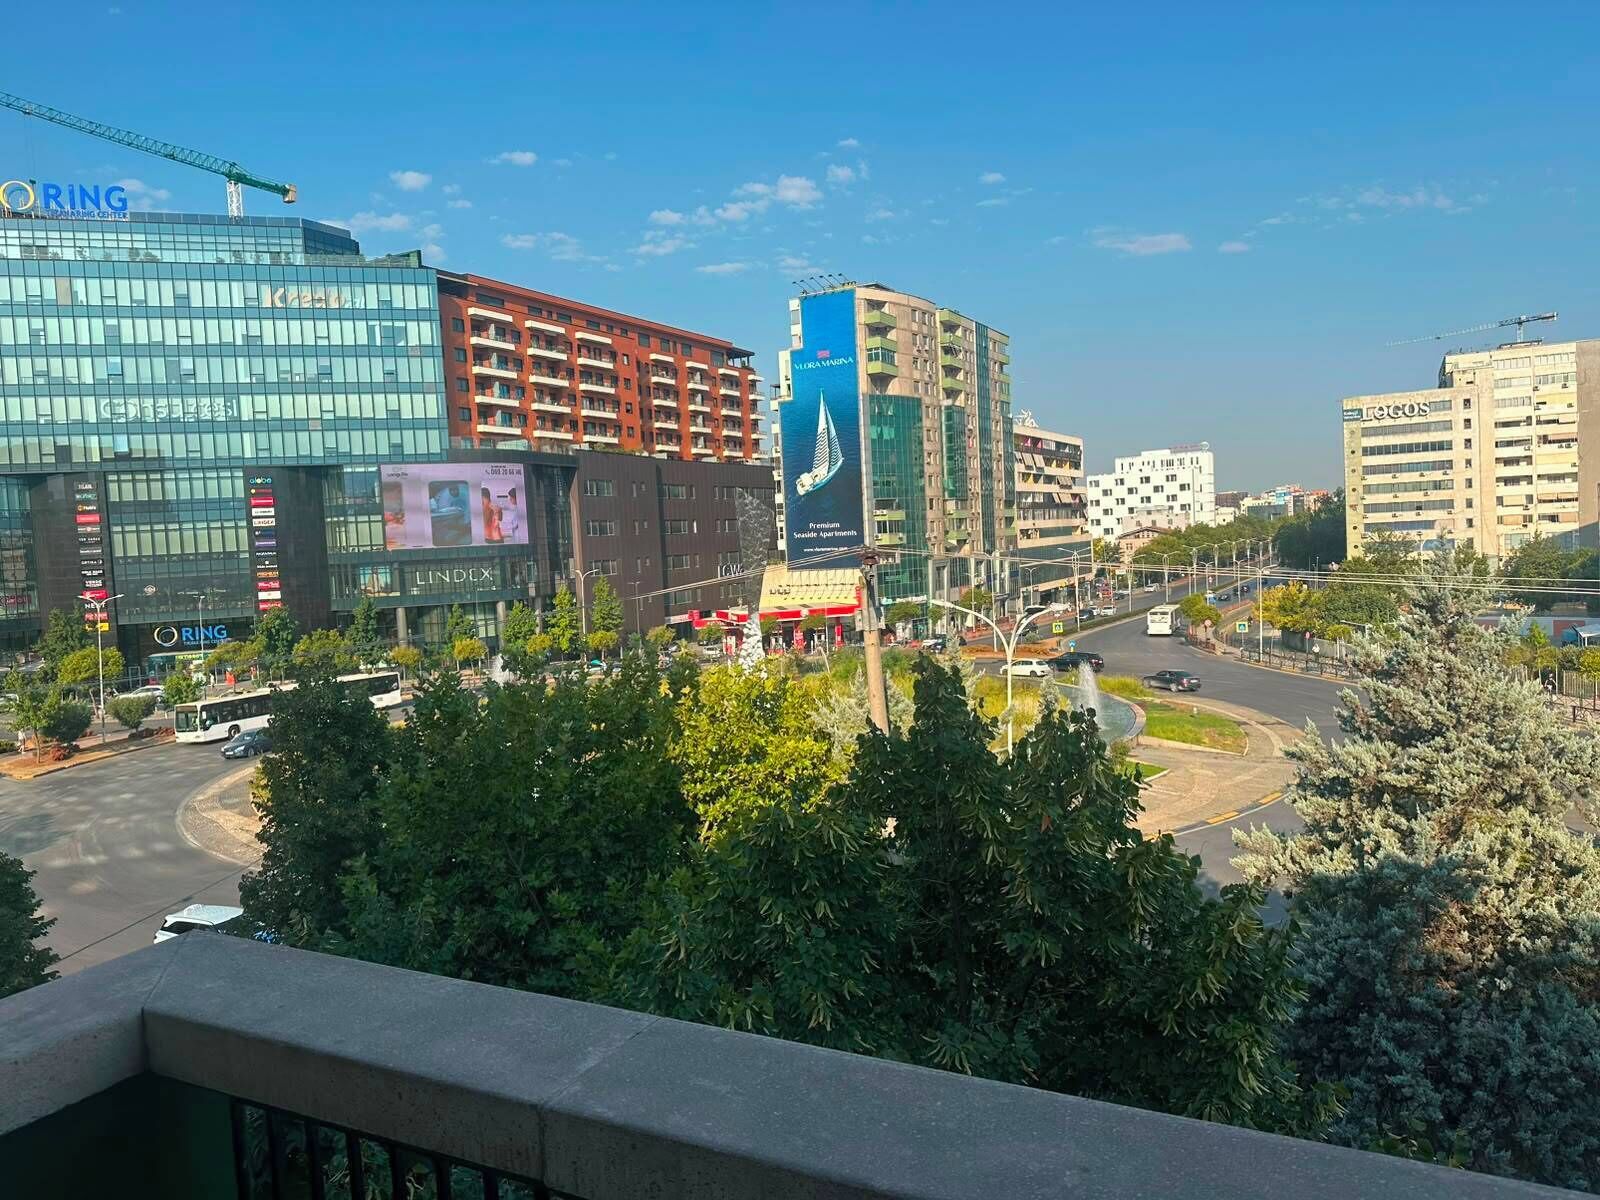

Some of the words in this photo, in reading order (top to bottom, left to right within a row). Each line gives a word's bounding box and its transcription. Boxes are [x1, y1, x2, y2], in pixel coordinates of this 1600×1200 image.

[43, 183, 128, 212] RING
[794, 360, 820, 370] VLORA
[821, 355, 854, 368] MARINA
[1361, 401, 1431, 422] LOGOS
[793, 530, 818, 539] Seaside
[819, 529, 858, 539] Apartments
[416, 567, 494, 585] LINDEX
[181, 625, 227, 641] RING
